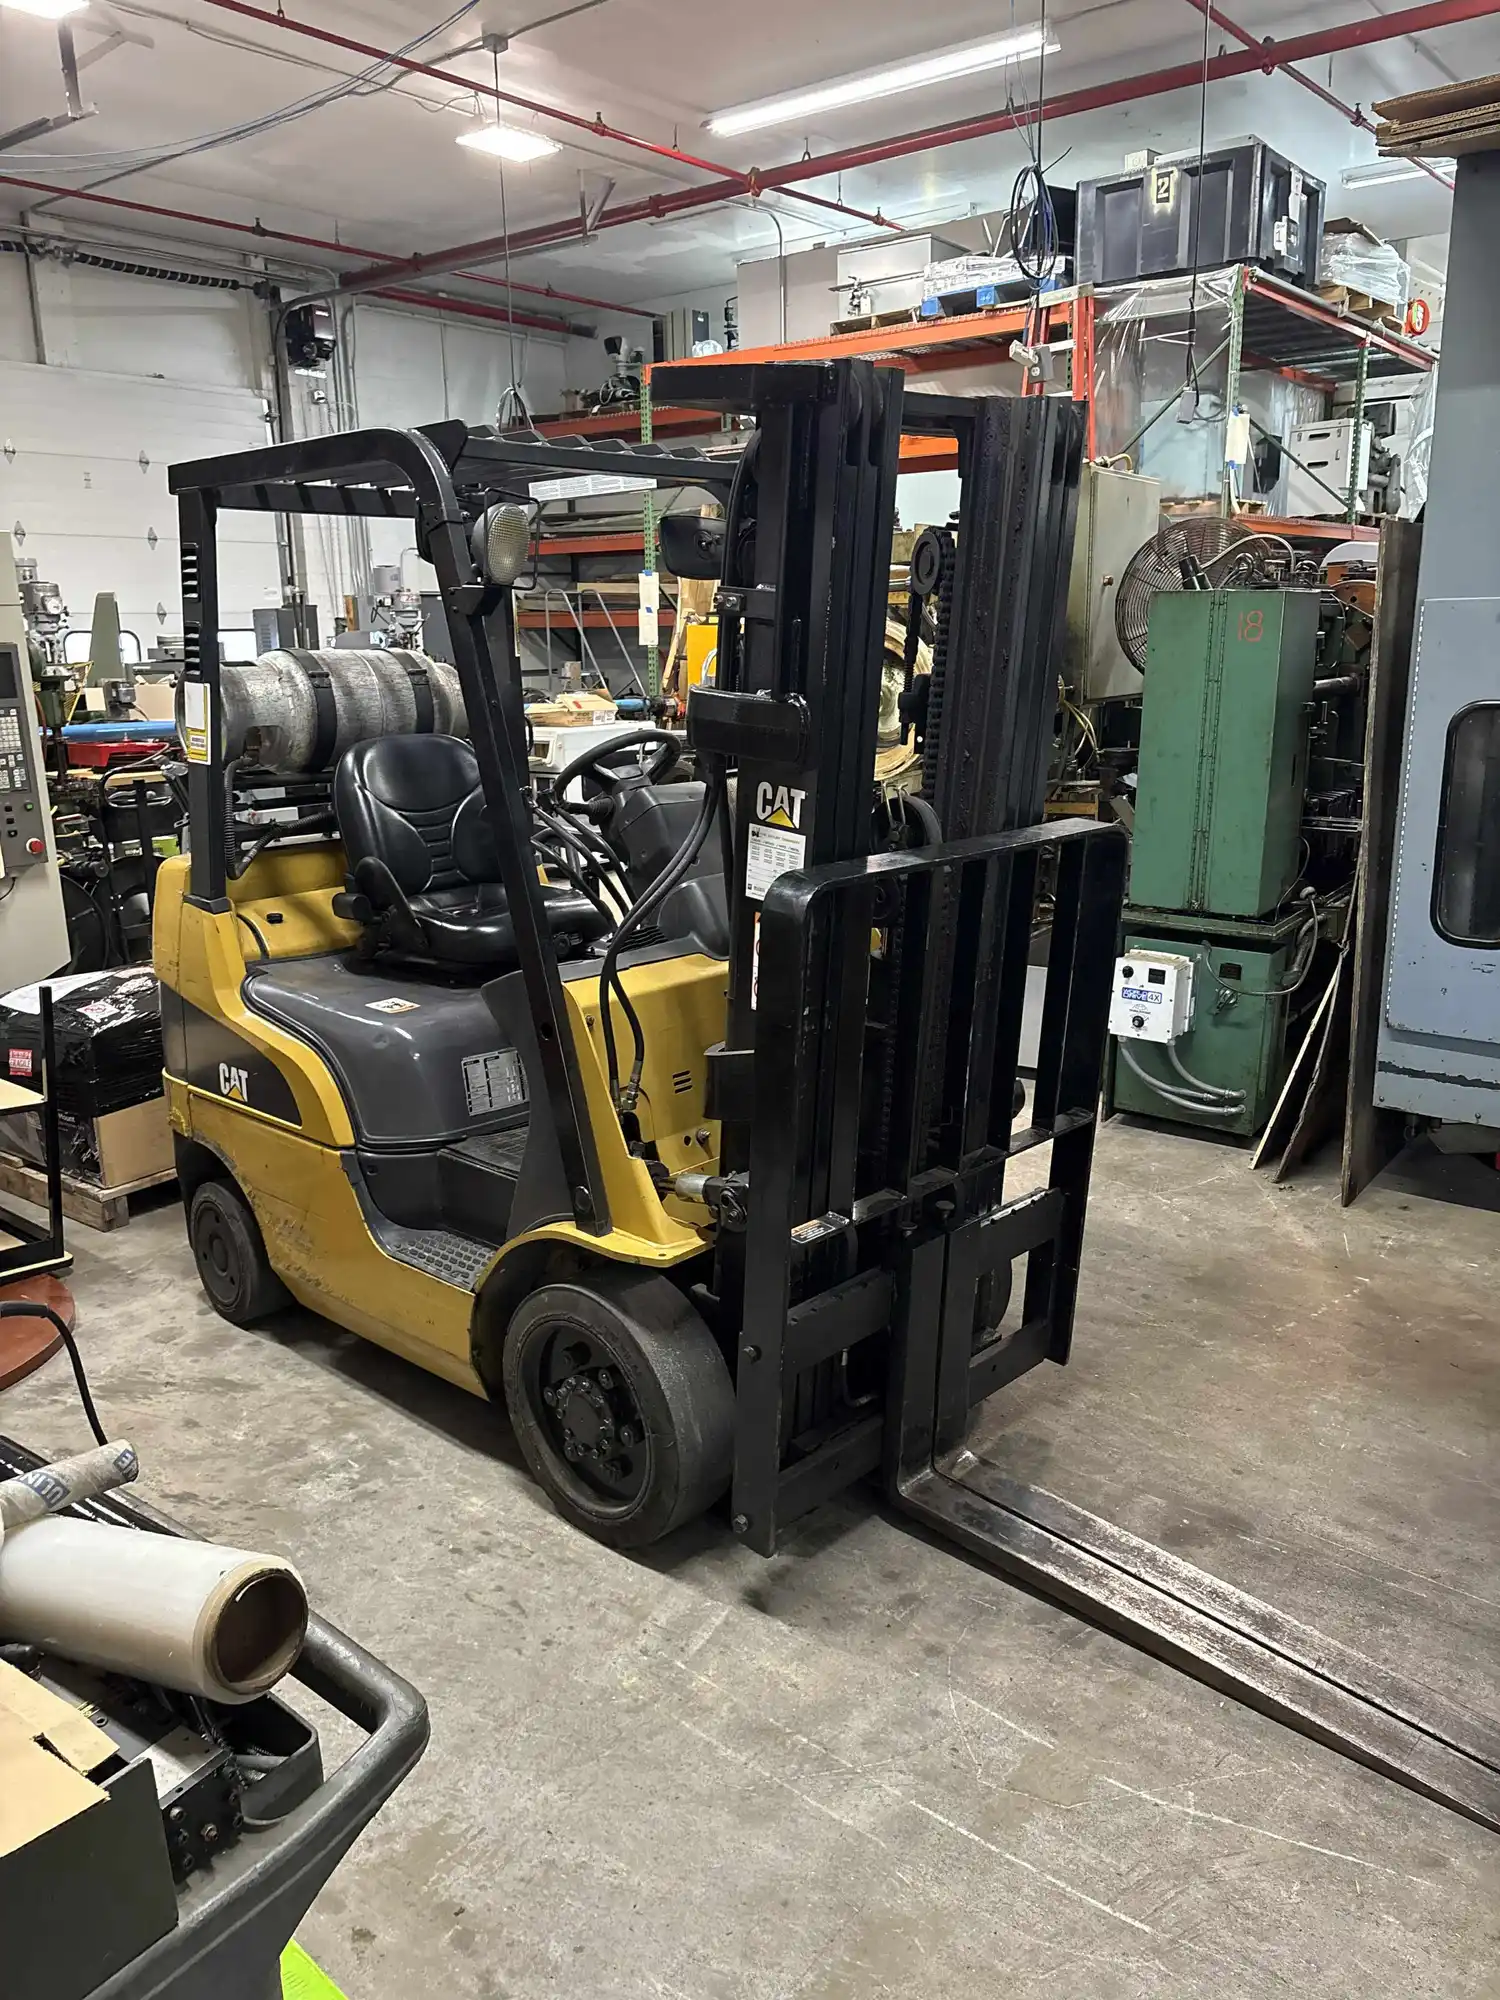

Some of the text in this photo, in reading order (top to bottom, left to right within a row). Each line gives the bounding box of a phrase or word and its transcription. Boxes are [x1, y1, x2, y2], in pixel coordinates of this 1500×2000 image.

[1157, 177, 1169, 199] 2
[1237, 610, 1263, 642] 18
[757, 781, 806, 829] CAT
[1149, 993, 1161, 1003] 4X
[219, 1062, 248, 1102] CAT
[21, 1471, 66, 1504] ULIN
